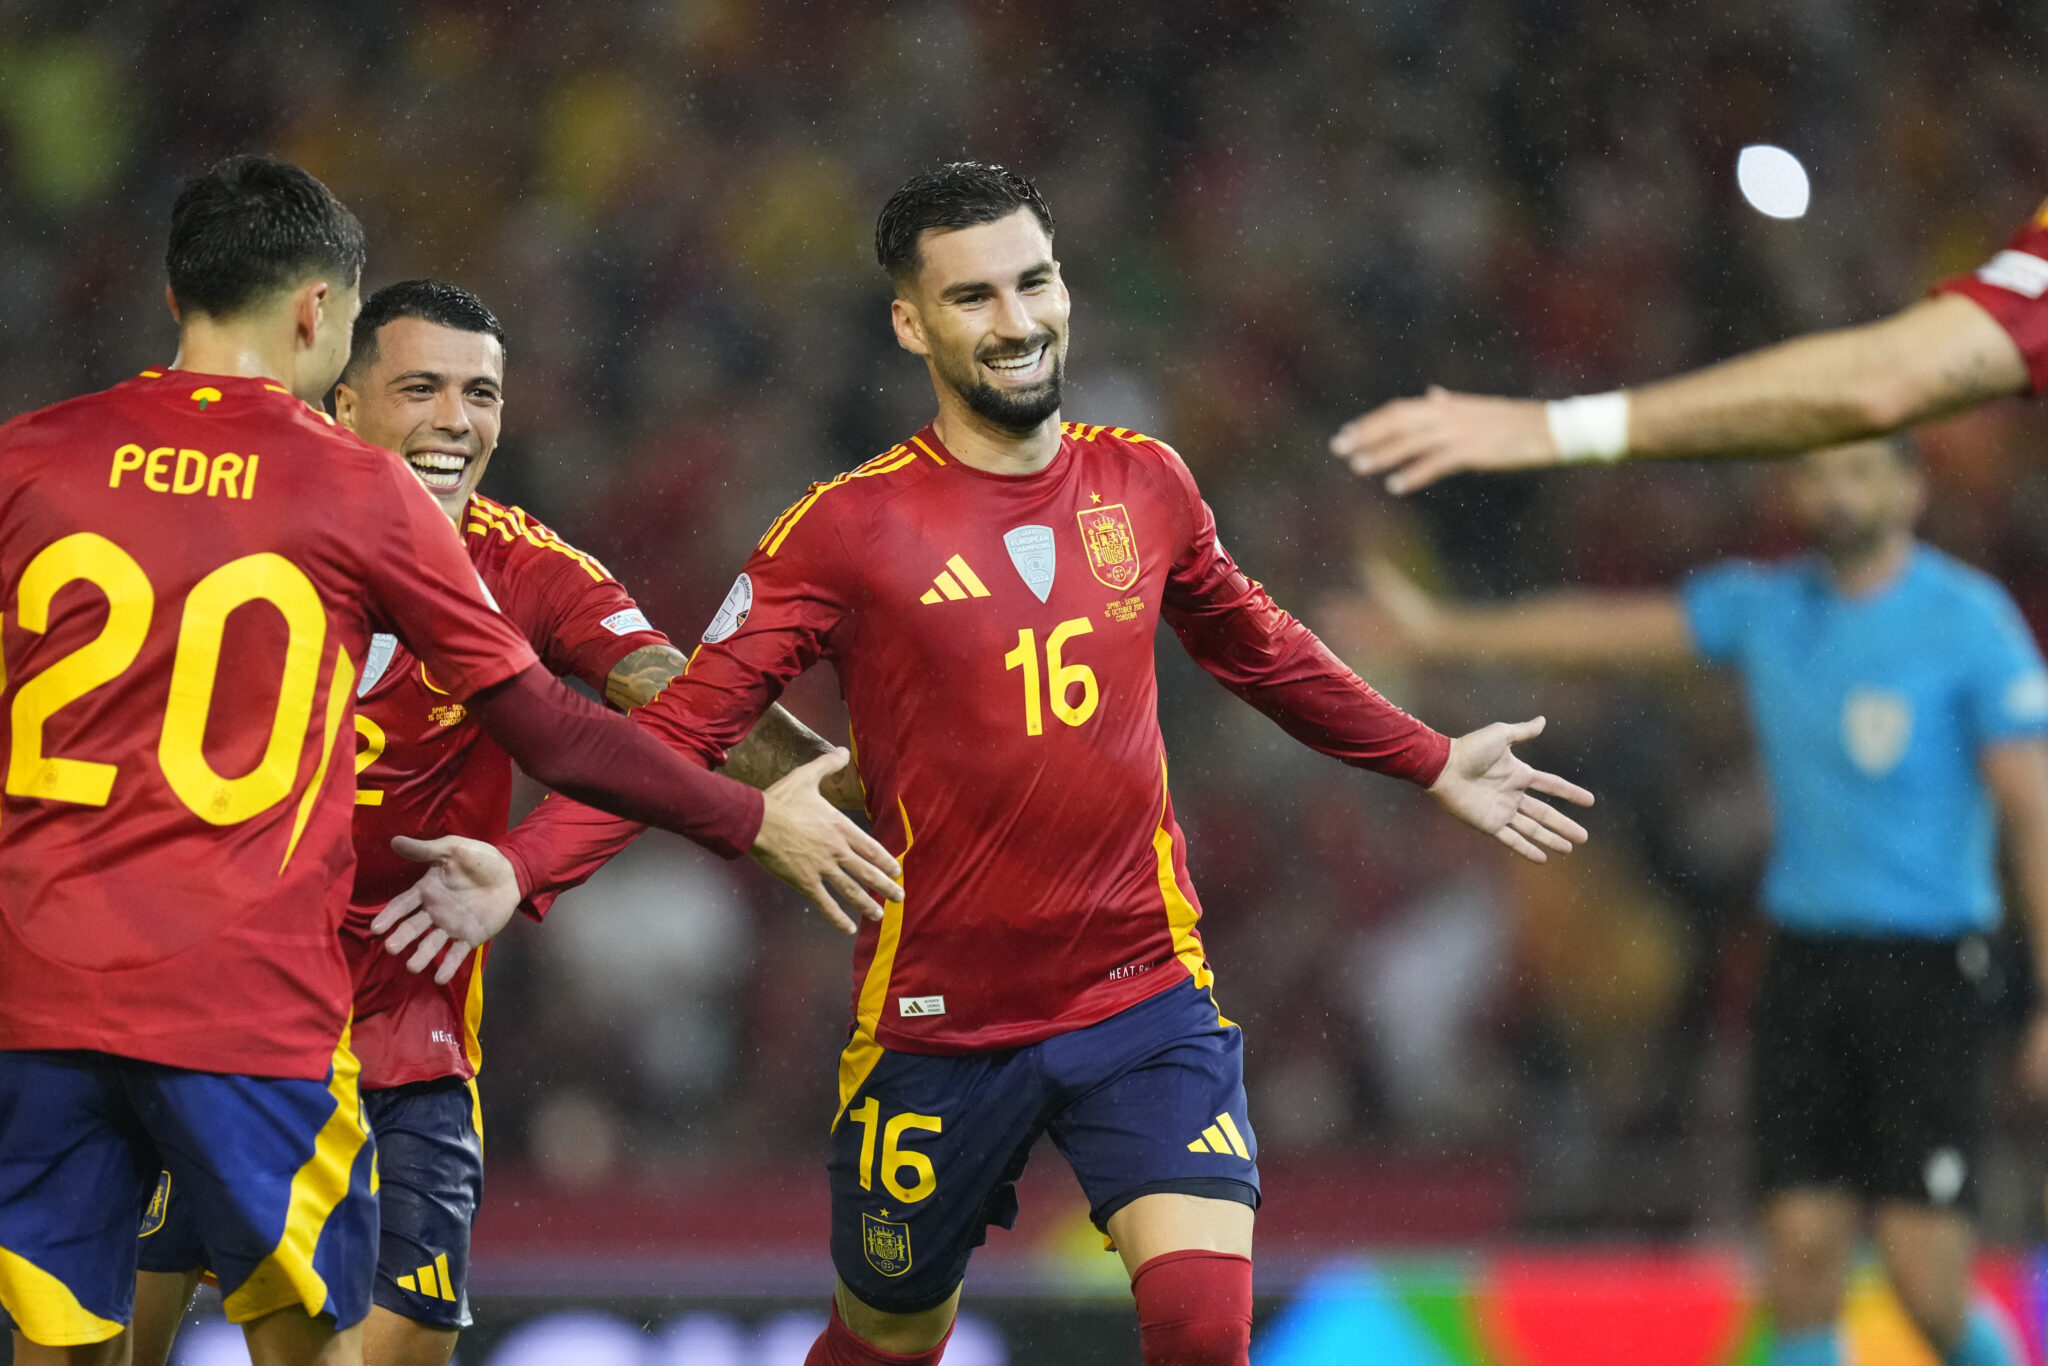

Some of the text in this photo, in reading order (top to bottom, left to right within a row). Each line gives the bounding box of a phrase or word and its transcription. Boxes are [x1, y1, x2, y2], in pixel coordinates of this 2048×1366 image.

[109, 443, 259, 500] PEDRI
[5, 531, 327, 826] 20
[1005, 617, 1099, 736] 16
[849, 1096, 942, 1204] 16
